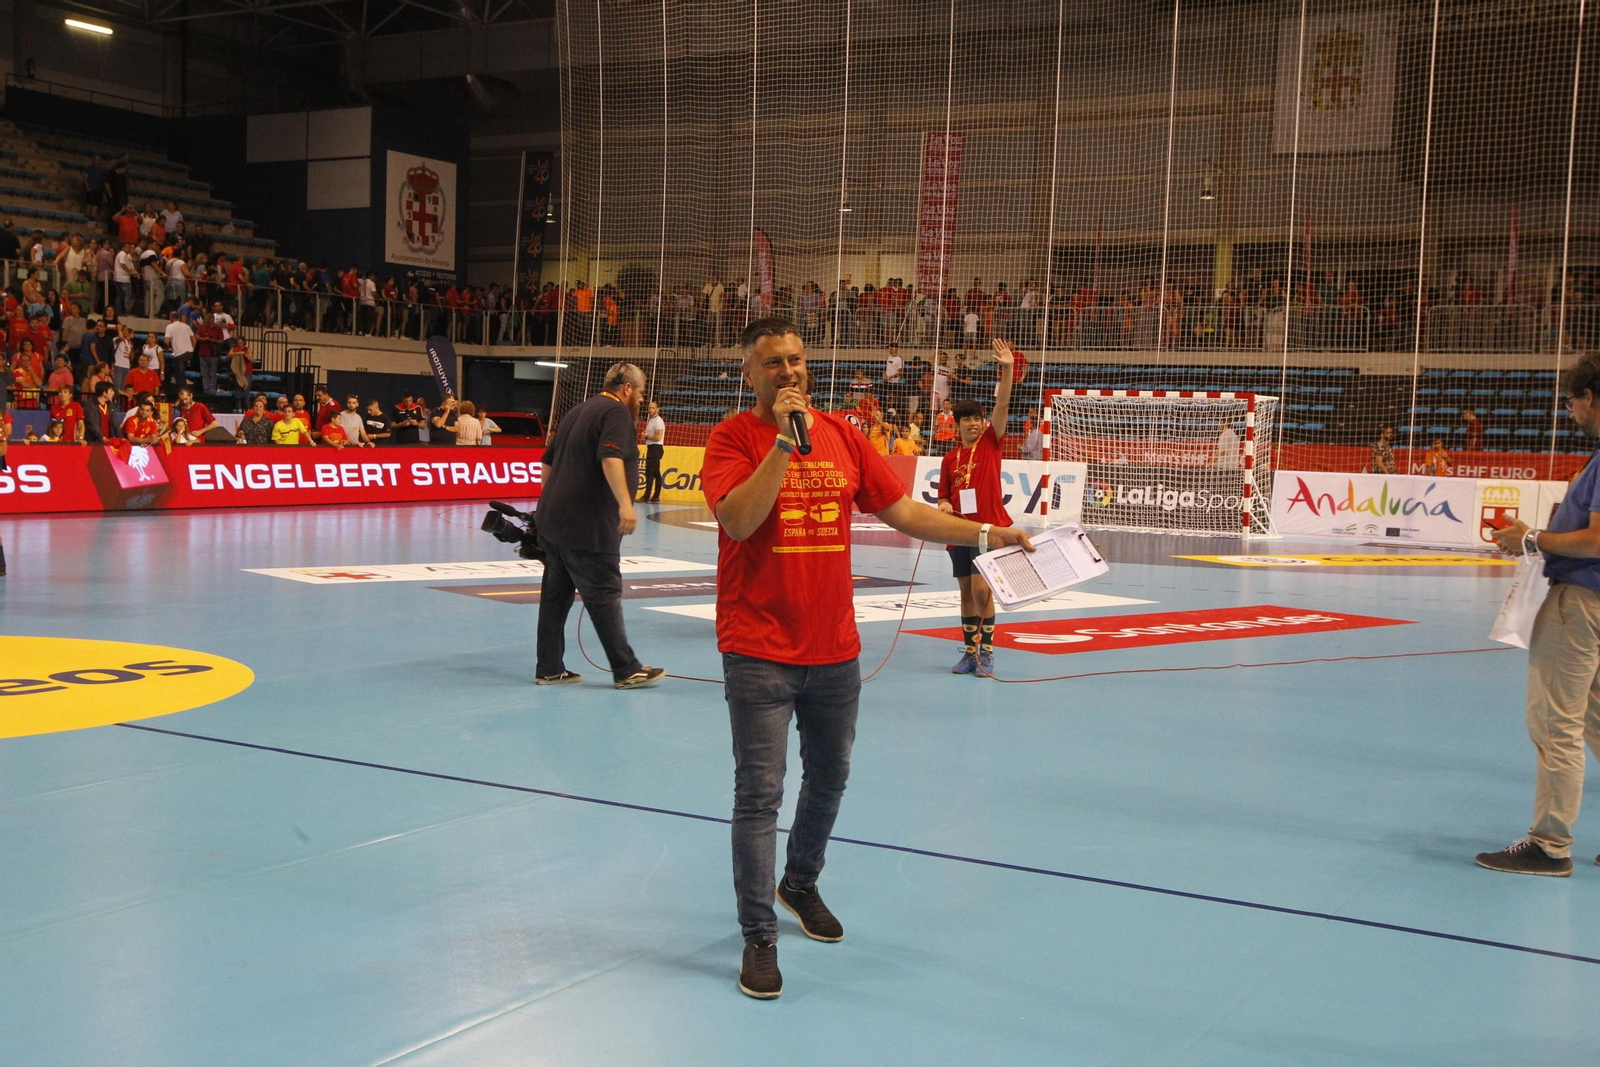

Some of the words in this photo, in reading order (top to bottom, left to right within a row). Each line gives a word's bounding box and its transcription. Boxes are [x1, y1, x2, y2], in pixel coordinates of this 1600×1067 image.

[188, 463, 401, 490] ENGELBERT
[411, 462, 542, 485] STRAUSS
[802, 470, 824, 478] EURO
[1457, 465, 1487, 477] EHF
[1490, 466, 1537, 479] EURO
[790, 478, 821, 489] EURO
[824, 478, 848, 488] CUP
[1286, 476, 1463, 524] Andalucía
[783, 527, 806, 537] ESPAÑA
[816, 527, 838, 537] SUECIA
[1075, 614, 1345, 638] Santander
